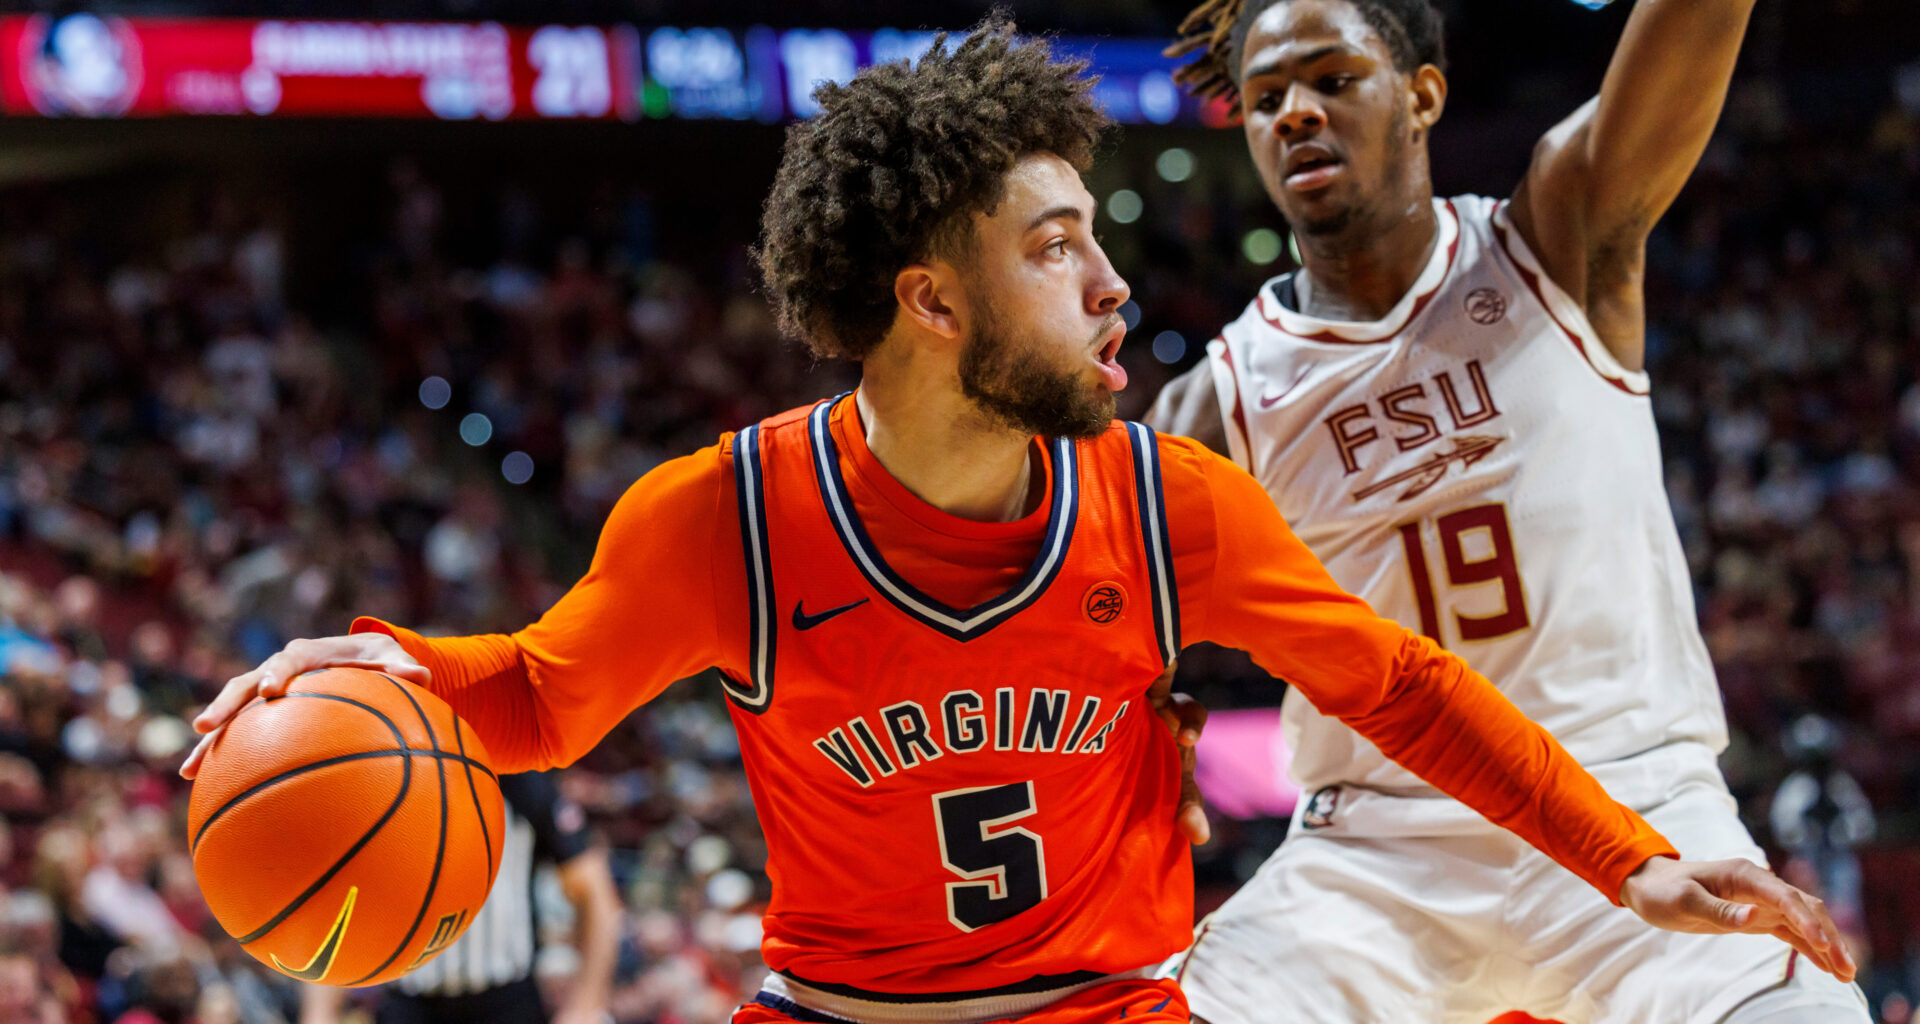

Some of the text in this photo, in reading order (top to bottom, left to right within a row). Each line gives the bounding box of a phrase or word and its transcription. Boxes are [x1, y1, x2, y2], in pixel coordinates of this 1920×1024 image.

[1323, 358, 1502, 477] FSU
[1395, 501, 1532, 650] 19
[931, 779, 1048, 934] 5
